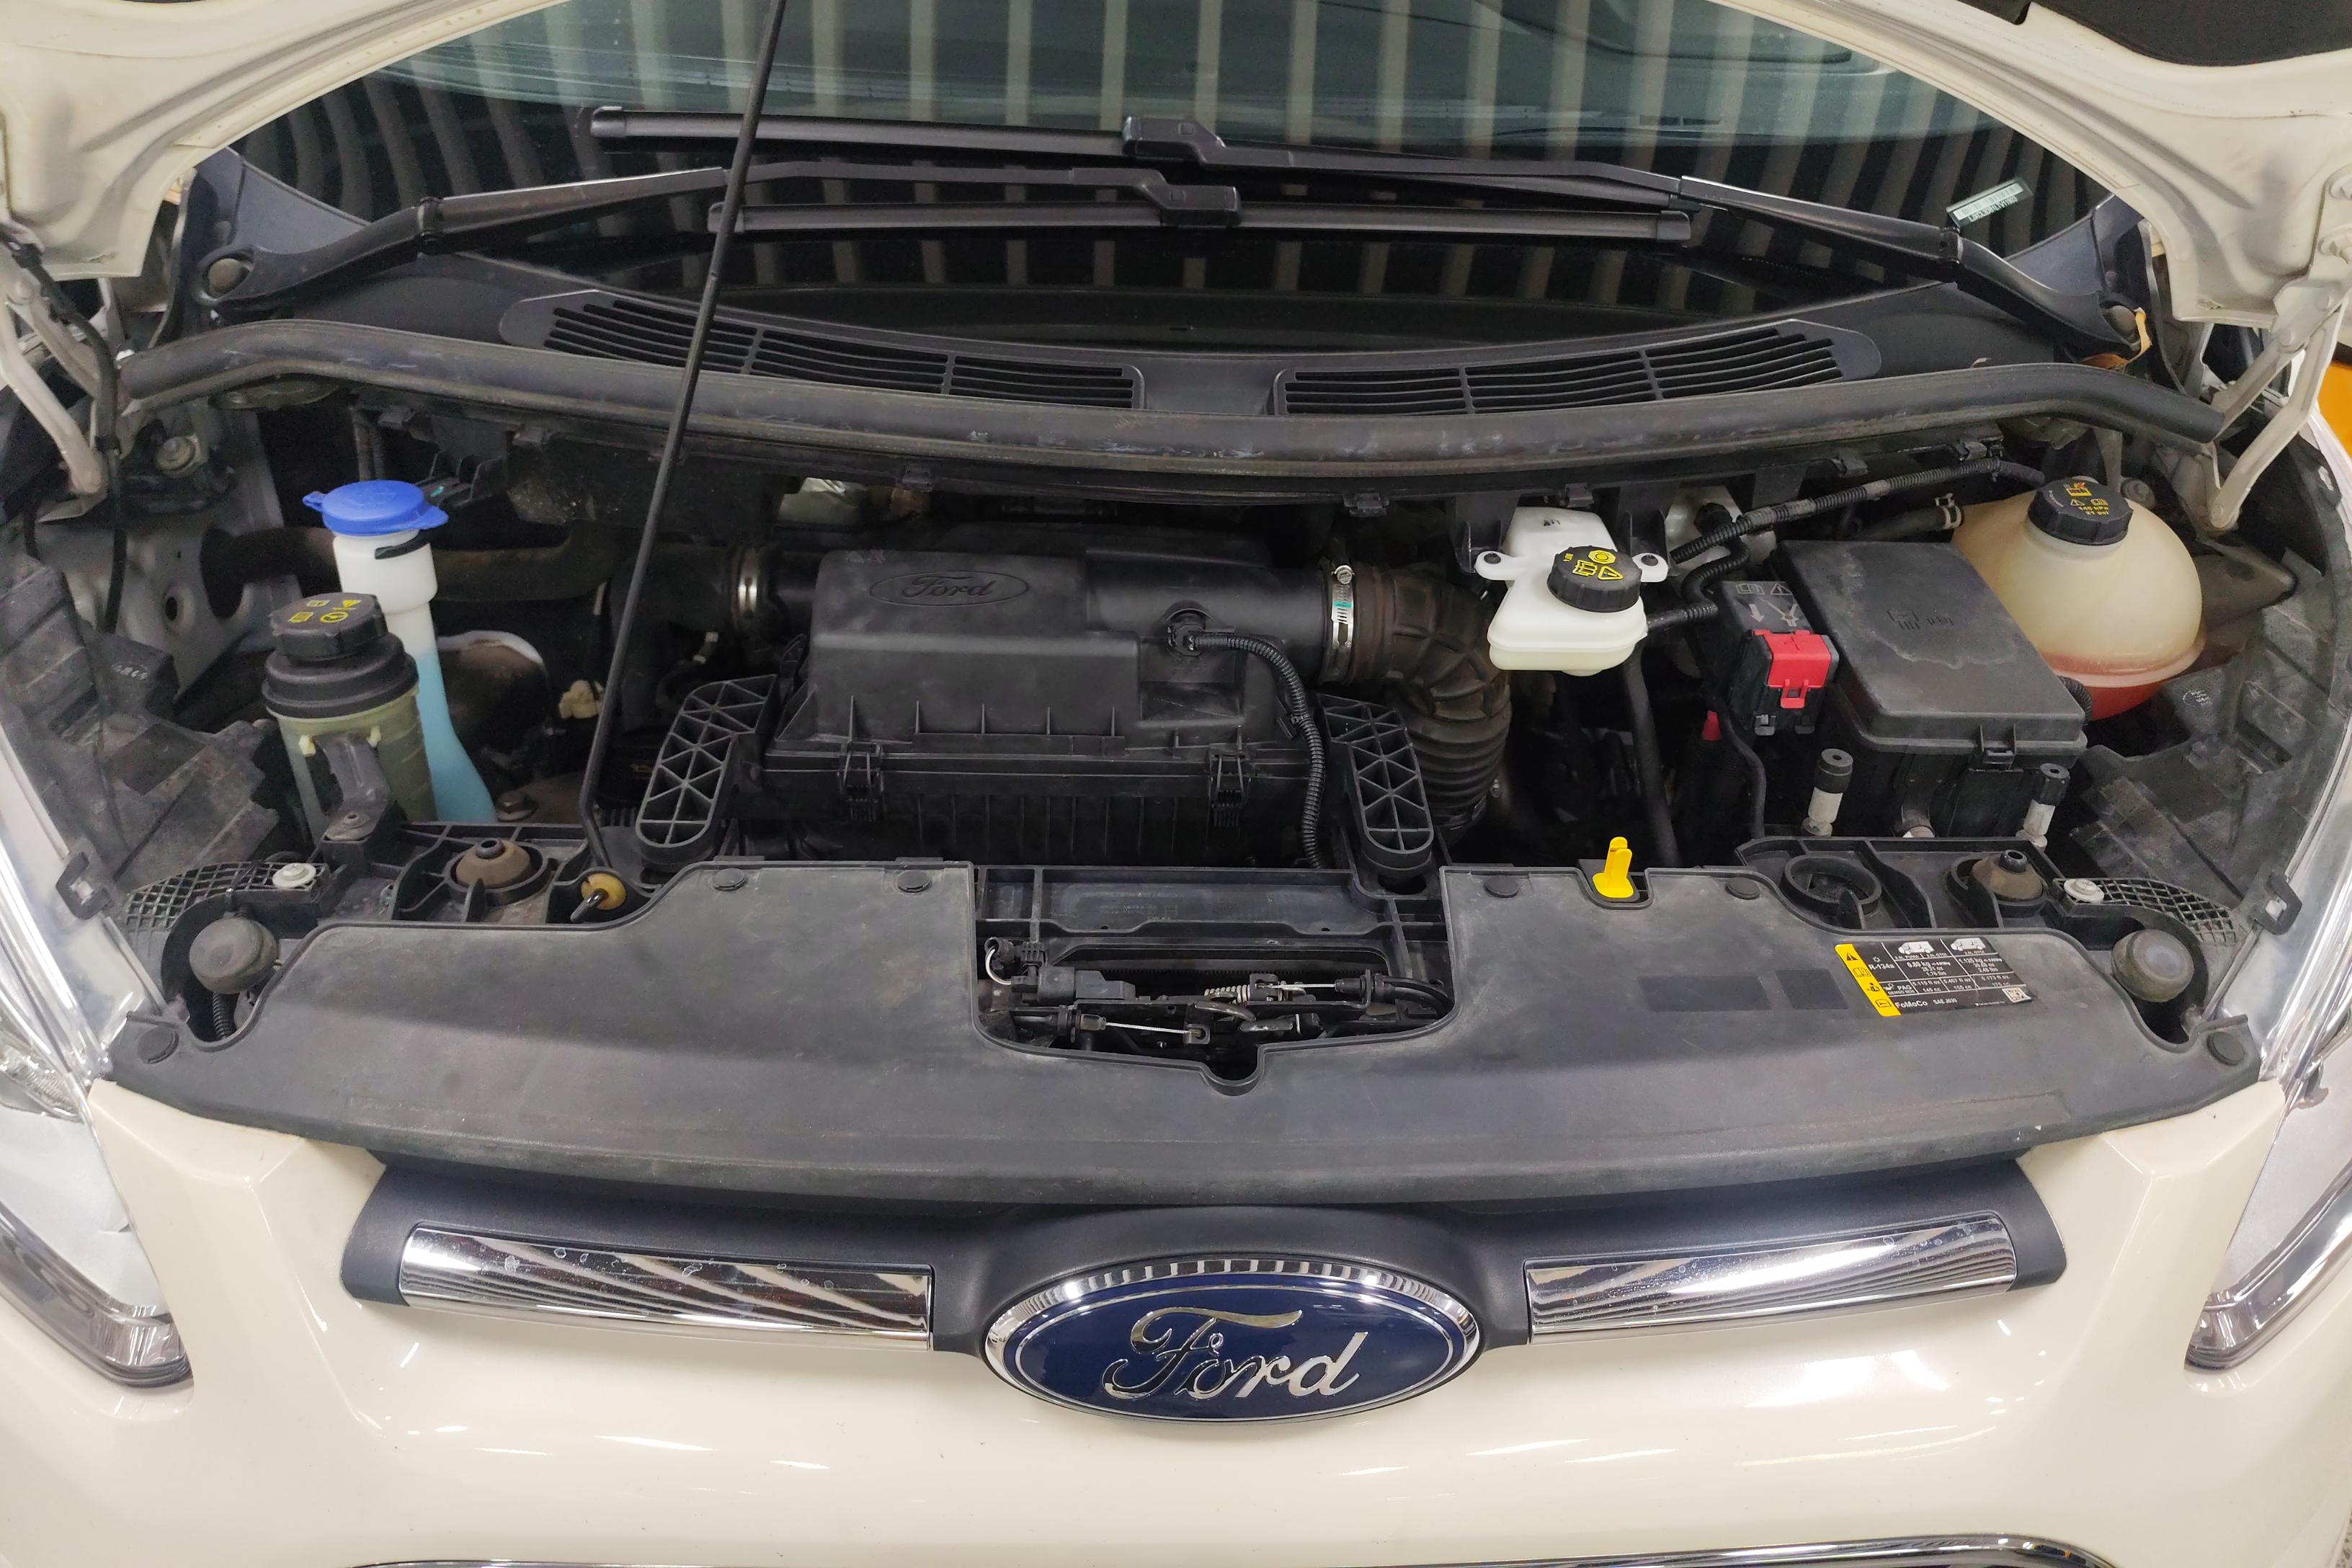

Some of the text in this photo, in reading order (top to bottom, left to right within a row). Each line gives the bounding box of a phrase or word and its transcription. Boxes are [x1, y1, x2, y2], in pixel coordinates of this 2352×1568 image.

[901, 576, 996, 598] Ford
[1921, 961, 1931, 969] kg
[1102, 1306, 1368, 1400] Ford
